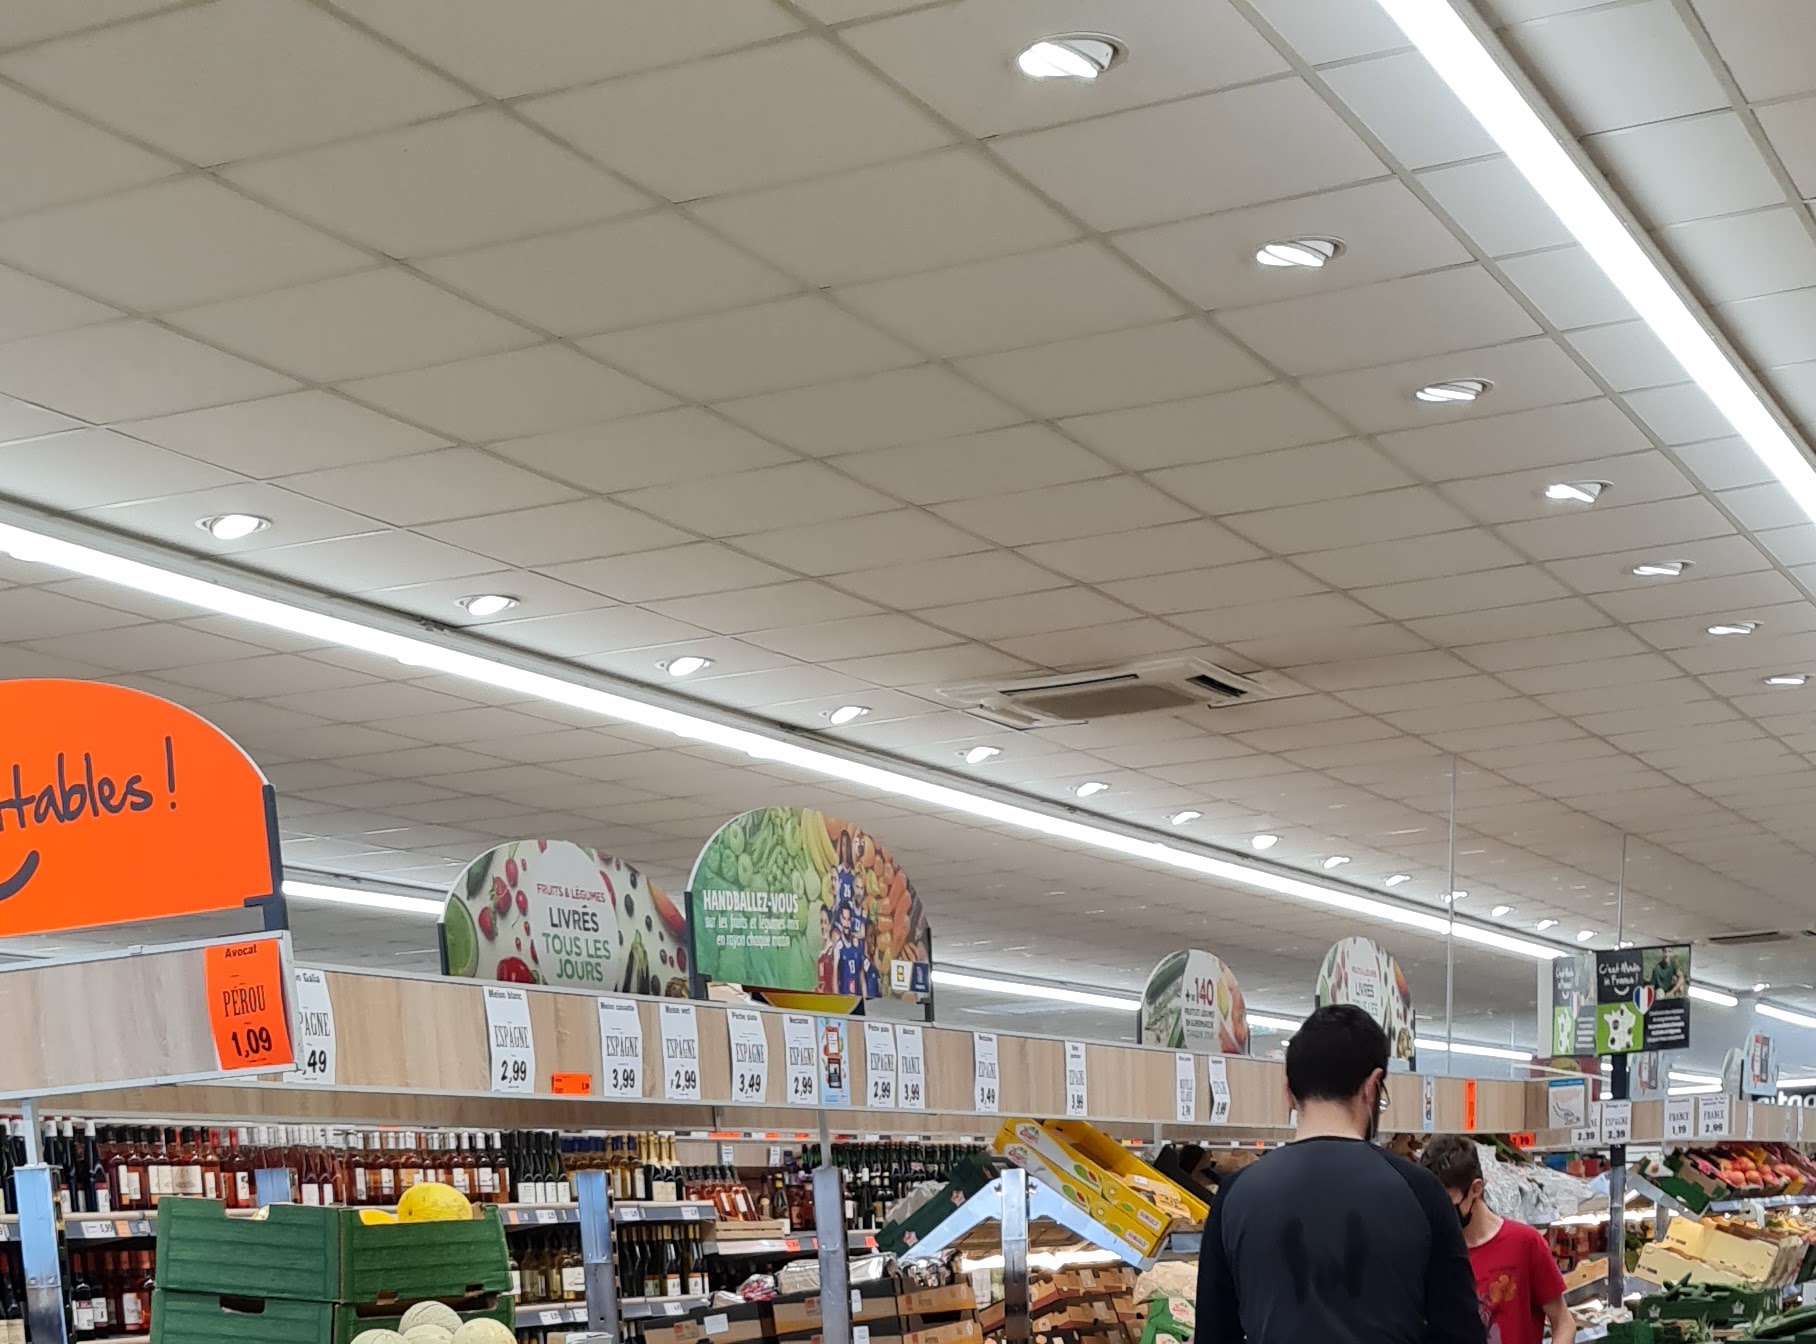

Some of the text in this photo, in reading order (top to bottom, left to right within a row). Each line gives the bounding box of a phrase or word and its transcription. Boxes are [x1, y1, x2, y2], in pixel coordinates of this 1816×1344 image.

[0, 752, 153, 825] tables
[536, 883, 563, 897] FRUITS
[703, 889, 798, 913] HANDBALLEZ-VOUS
[548, 904, 600, 932] LIVRÉS
[542, 932, 611, 960] TOUS LES
[556, 958, 604, 982] JOURS
[223, 984, 266, 1017] PÉROU
[1194, 977, 1214, 1006] 140
[299, 1012, 331, 1037] PAGNE
[231, 1026, 272, 1058] 1,09
[494, 1025, 530, 1048] ESPAGNE
[606, 1035, 639, 1057] ESPAGNE
[666, 1038, 696, 1059] ESPAGNE
[735, 1042, 764, 1063] ESPAGNE
[302, 1049, 327, 1075] ,49
[501, 1060, 527, 1083] 2,99
[612, 1068, 635, 1090] 3,99
[675, 1069, 697, 1091] 2,99
[739, 1073, 761, 1094] 3,49
[794, 1076, 813, 1096] 2,99
[873, 1081, 890, 1100] 2,99
[904, 1083, 920, 1102] 3,99
